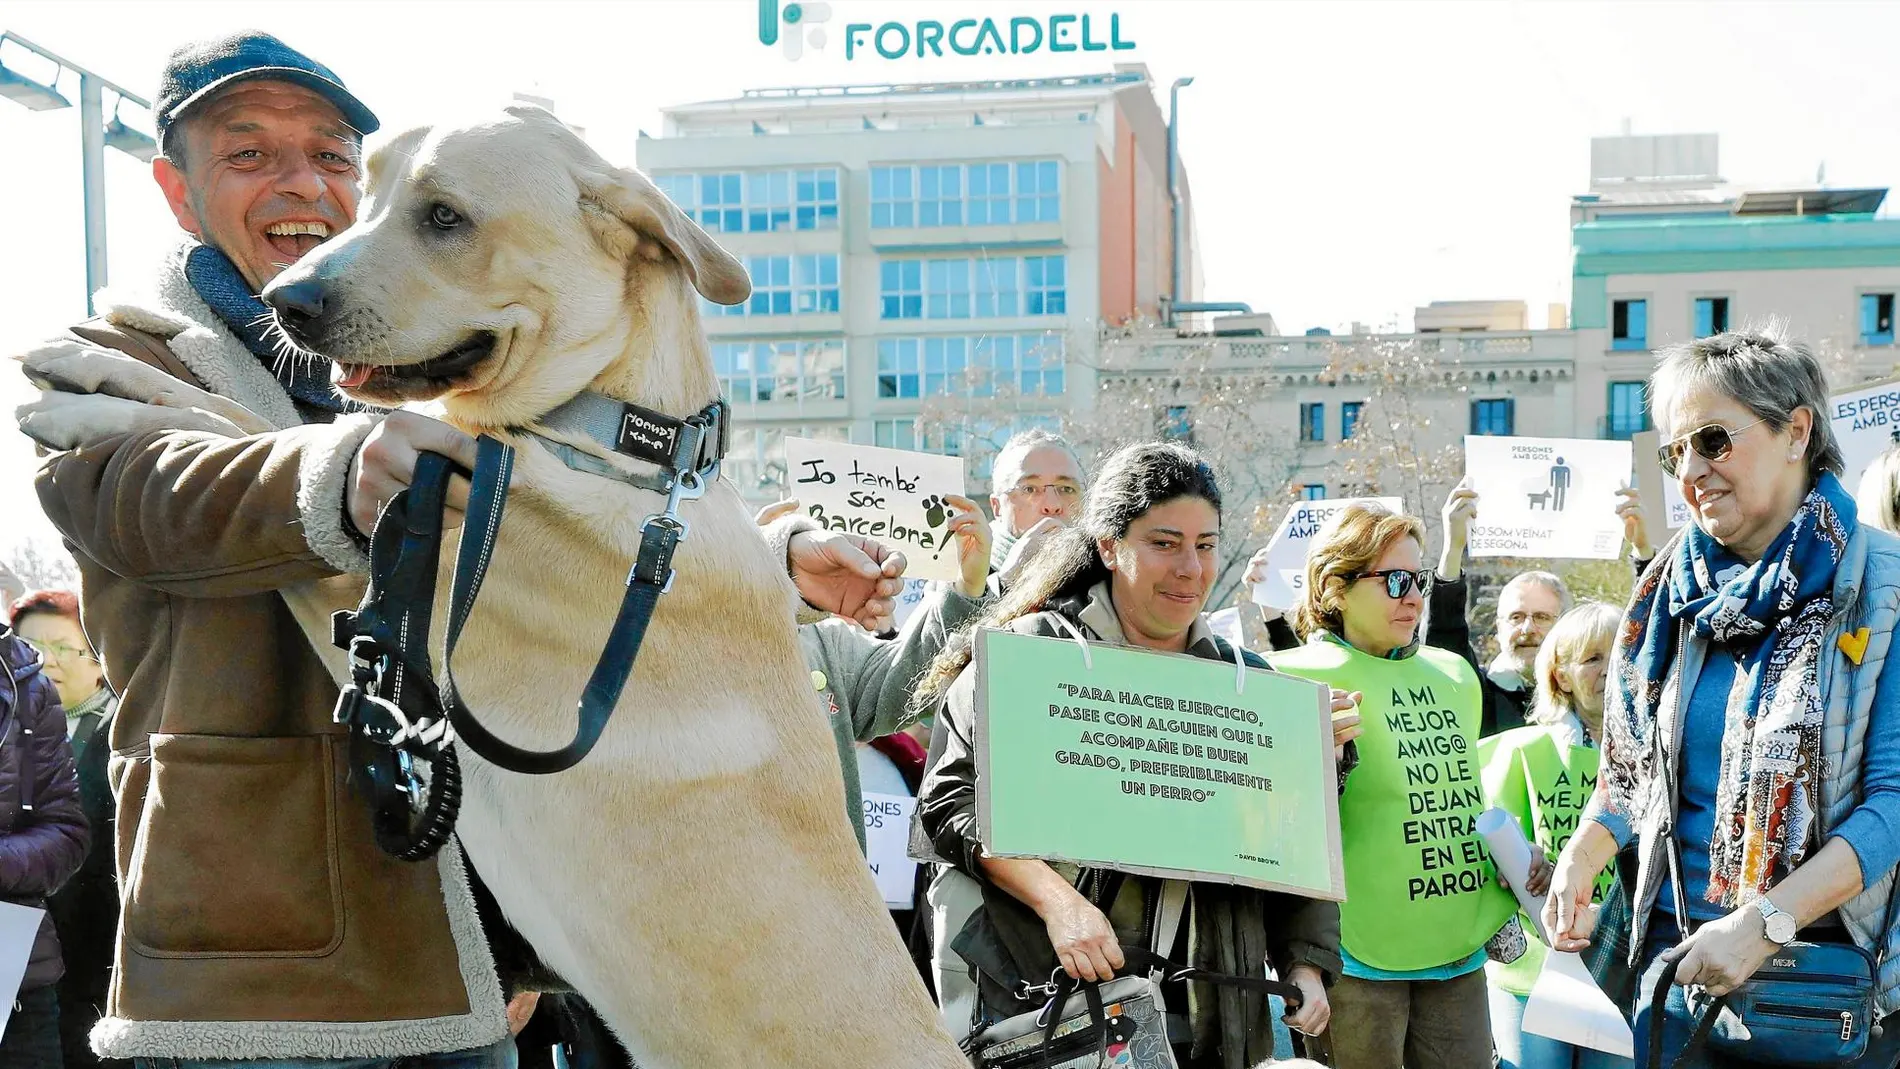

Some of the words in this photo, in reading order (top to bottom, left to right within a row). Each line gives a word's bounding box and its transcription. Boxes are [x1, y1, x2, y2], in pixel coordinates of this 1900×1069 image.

[846, 12, 1136, 61] FORCADELL
[1859, 392, 1900, 413] PERS
[1852, 411, 1888, 432] AMB
[1511, 445, 1553, 454] PERSONES
[797, 459, 836, 485] Jo
[848, 460, 920, 493] també
[1297, 507, 1342, 523] PERS
[1471, 526, 1486, 537] NO
[1487, 527, 1513, 538] SOM
[1471, 538, 1483, 549] DE
[1484, 539, 1528, 550] SEGONA
[1391, 687, 1405, 707] A
[1407, 685, 1436, 704] MI
[1118, 691, 1174, 711] HACER
[1178, 699, 1264, 727] EJERCICIO,
[1384, 709, 1461, 732] MEJOR
[1049, 704, 1100, 723] PASEE
[1104, 711, 1143, 728] CON
[1146, 718, 1218, 739] ALGUIEN
[1221, 728, 1254, 745] QUE
[1257, 734, 1274, 749] LE
[1080, 731, 1179, 756] ACOMPAÑE
[1182, 743, 1204, 758] DE
[1207, 747, 1249, 765] BUEN
[1397, 734, 1467, 759] AMIG@
[1055, 751, 1126, 773] GRADO,
[1130, 759, 1273, 792] PREFERIBLEMENTE
[1406, 763, 1439, 785] NO
[1447, 760, 1472, 782] LE
[1555, 770, 1571, 787] A
[1121, 780, 1146, 796] UN
[1408, 786, 1483, 815] DEJAN
[1537, 790, 1592, 810] MEJ
[1403, 812, 1482, 845] ENTRA
[1239, 853, 1257, 861] DAVID
[1421, 846, 1455, 871] EN
